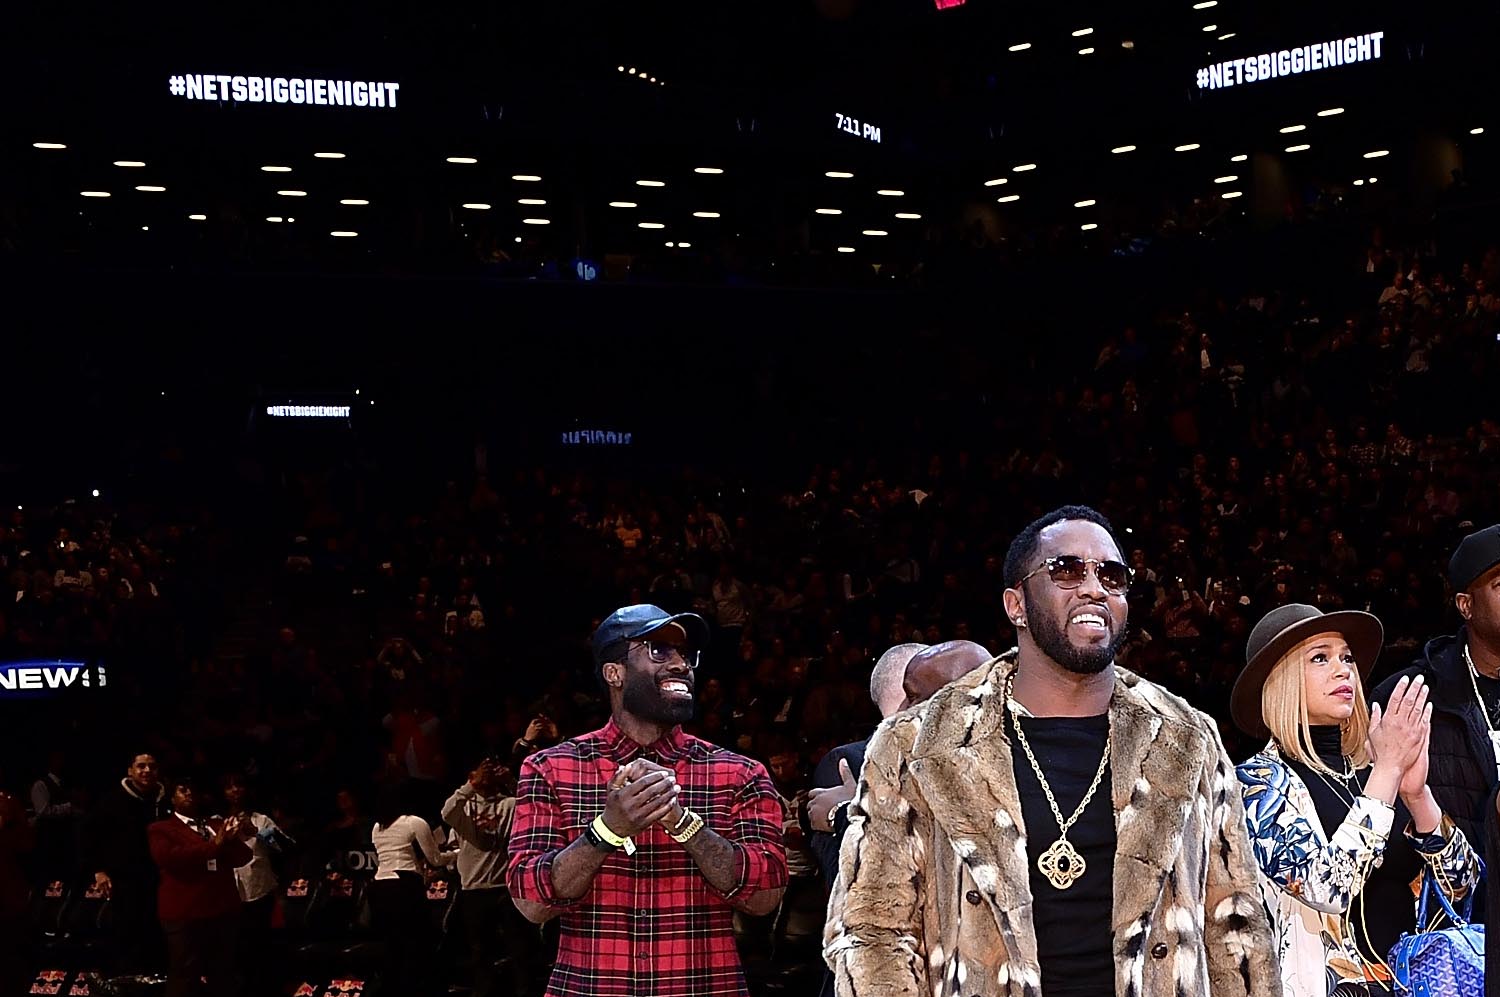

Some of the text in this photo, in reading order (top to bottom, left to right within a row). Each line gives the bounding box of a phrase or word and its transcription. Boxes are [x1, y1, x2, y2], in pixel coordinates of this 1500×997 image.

[1196, 30, 1384, 90] #NETSBIGGIENIGHT
[168, 73, 400, 108] #NETSBIGGIENIGHT
[835, 112, 881, 144] 7:11 PM
